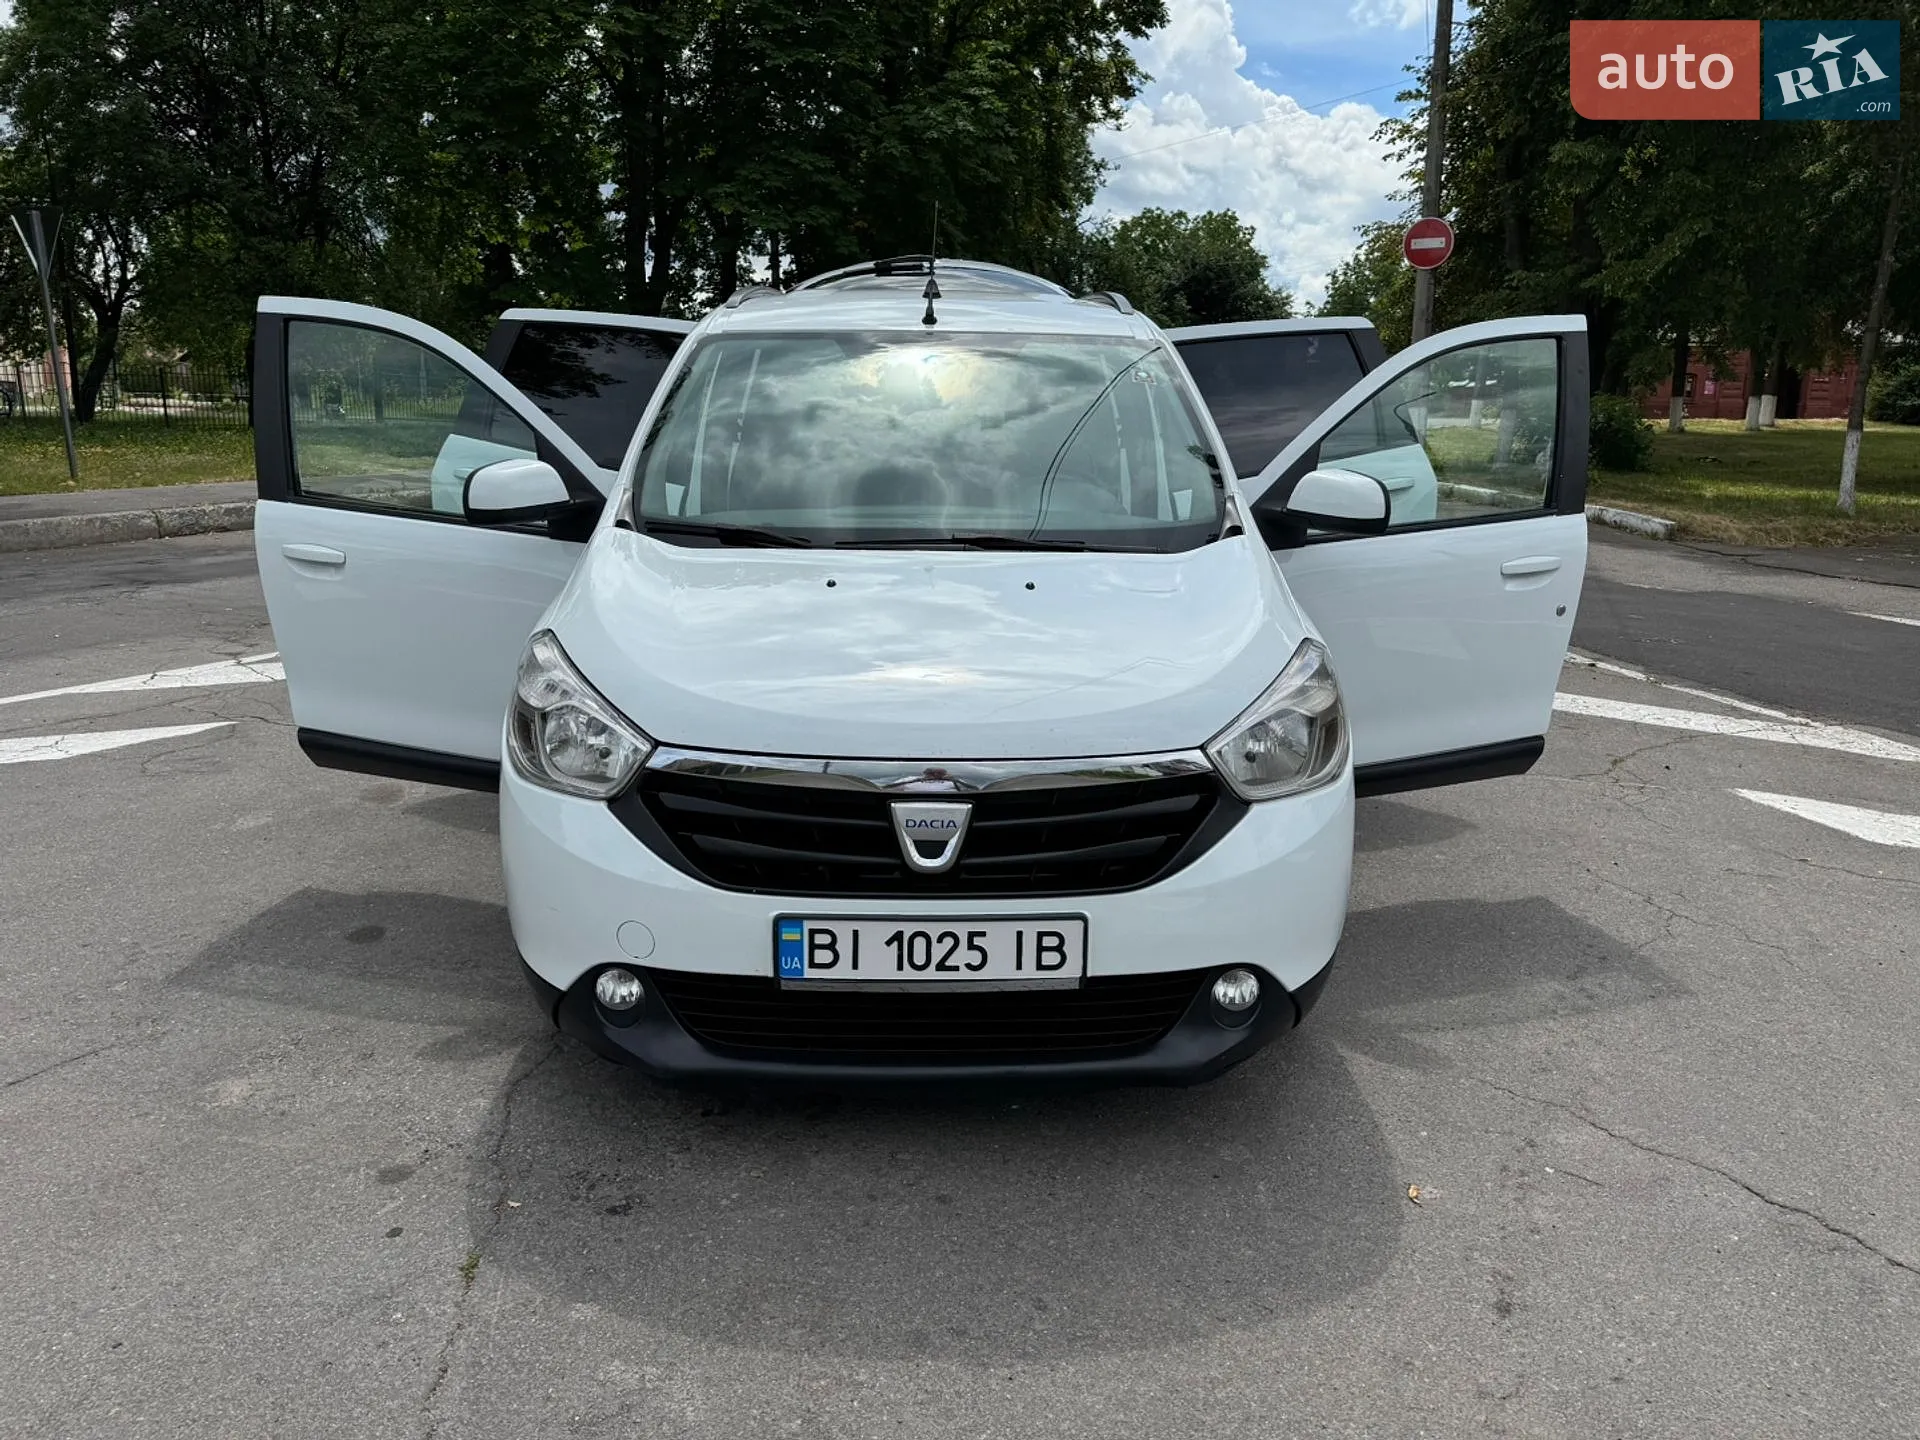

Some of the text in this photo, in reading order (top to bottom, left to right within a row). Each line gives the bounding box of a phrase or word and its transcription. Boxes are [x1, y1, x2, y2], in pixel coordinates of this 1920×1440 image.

[905, 819, 957, 829] DACIA
[808, 928, 1068, 971] BI 1025 IB
[782, 956, 801, 969] UA
